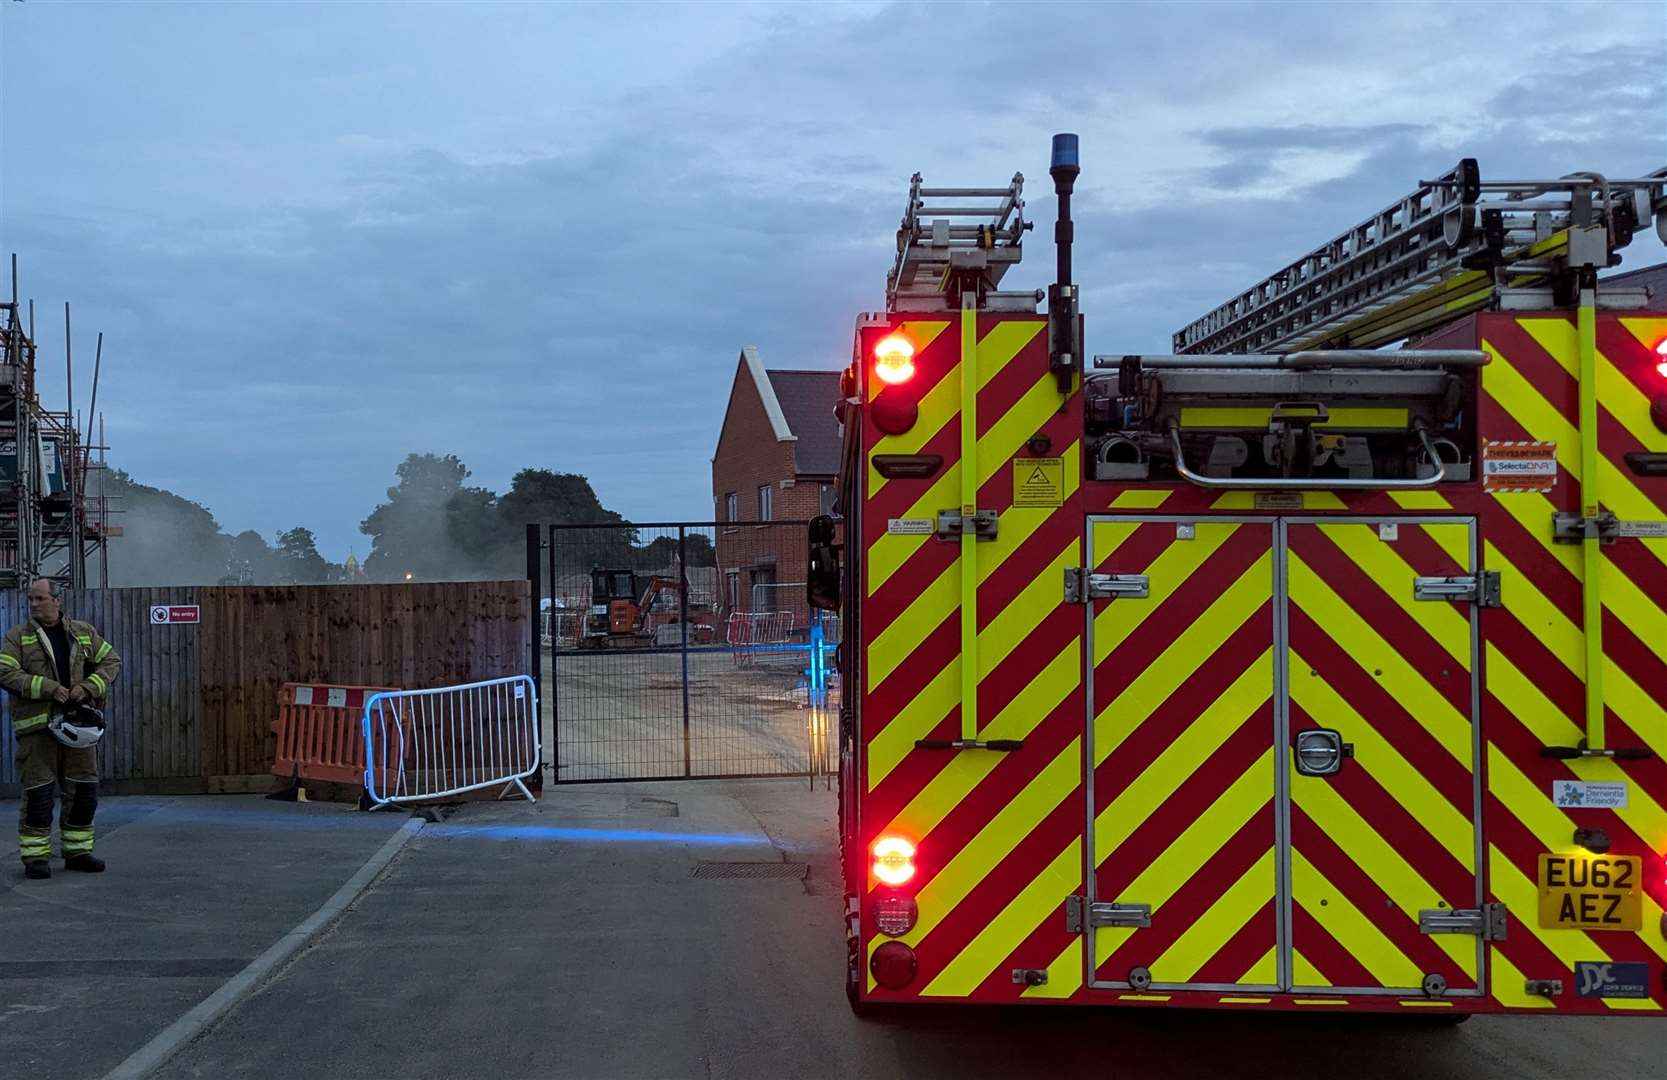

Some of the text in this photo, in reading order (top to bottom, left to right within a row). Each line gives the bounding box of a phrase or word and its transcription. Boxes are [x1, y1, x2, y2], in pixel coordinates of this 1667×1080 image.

[1586, 789, 1625, 798] Dementia
[1586, 797, 1620, 806] Friendly
[1547, 858, 1632, 888] EU62
[1559, 893, 1622, 923] AEZ
